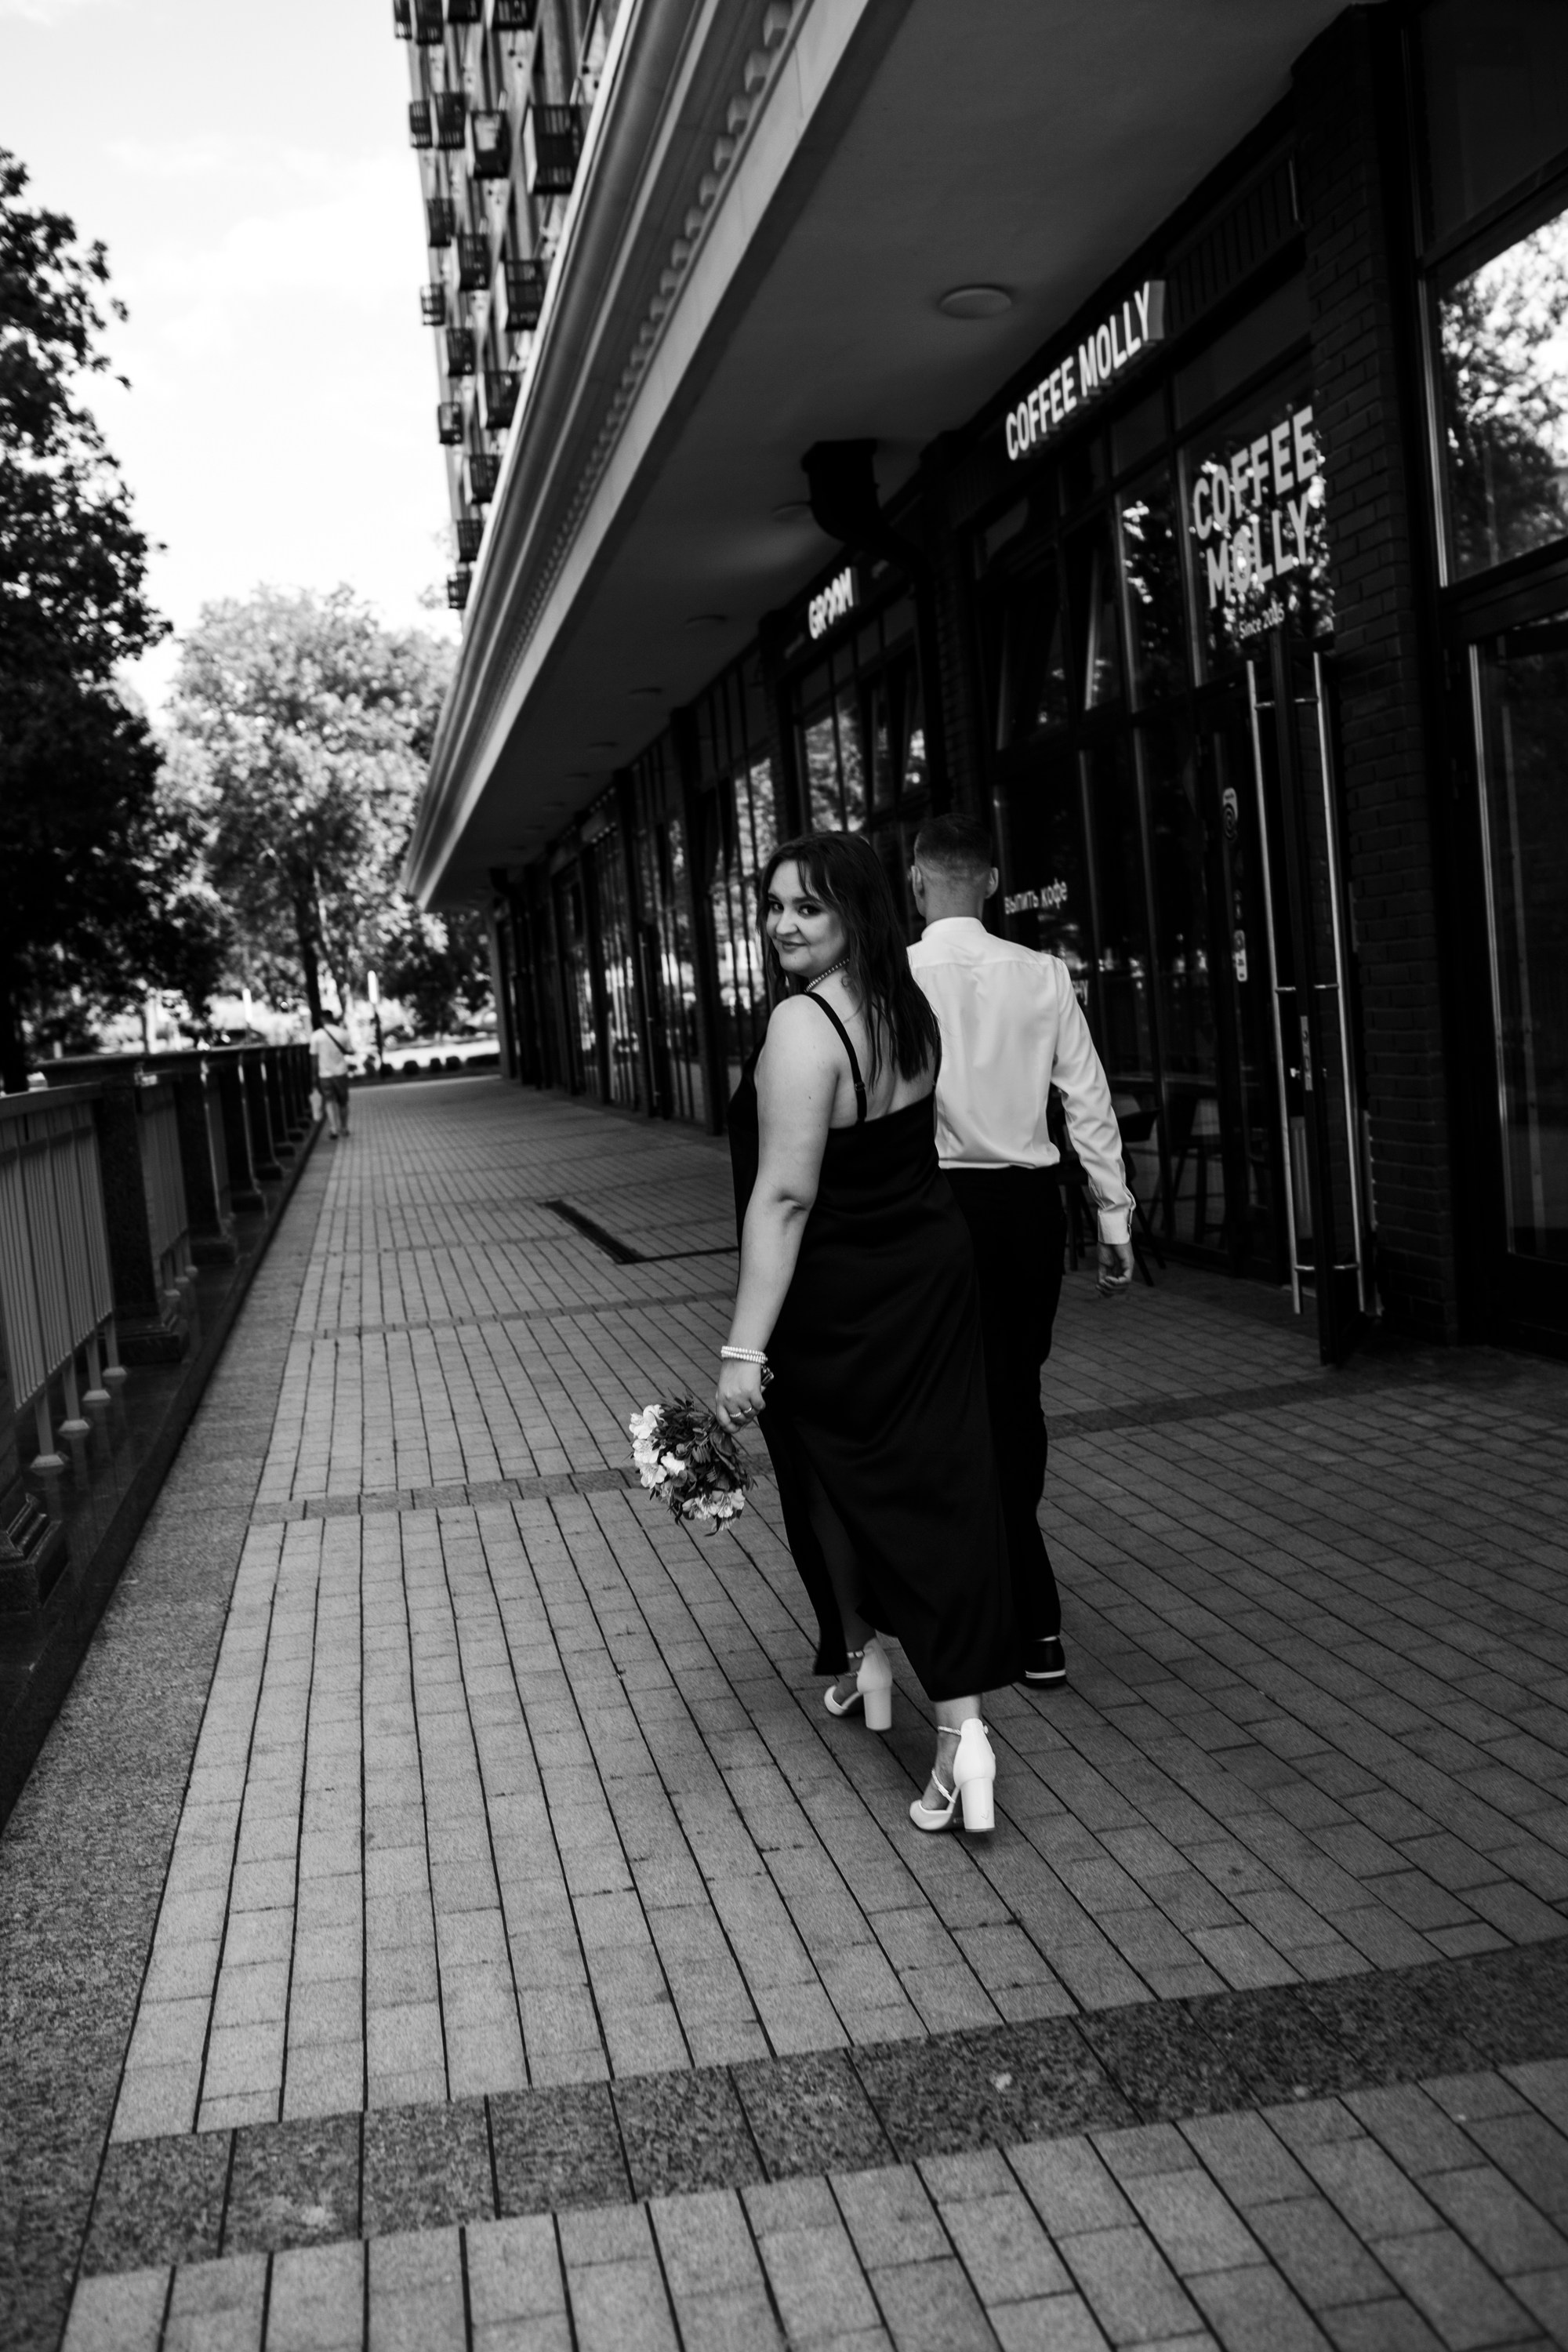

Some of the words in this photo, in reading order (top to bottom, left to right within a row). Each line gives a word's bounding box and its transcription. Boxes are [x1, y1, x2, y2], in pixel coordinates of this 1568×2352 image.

[1005, 355, 1077, 461] COFFEE
[1078, 281, 1150, 397] MOLLY
[1192, 405, 1316, 541] COFFEE
[1206, 491, 1308, 610] MOLLY
[1239, 619, 1262, 640] Since
[1004, 888, 1040, 915] выпить
[1039, 876, 1069, 909] кофе
